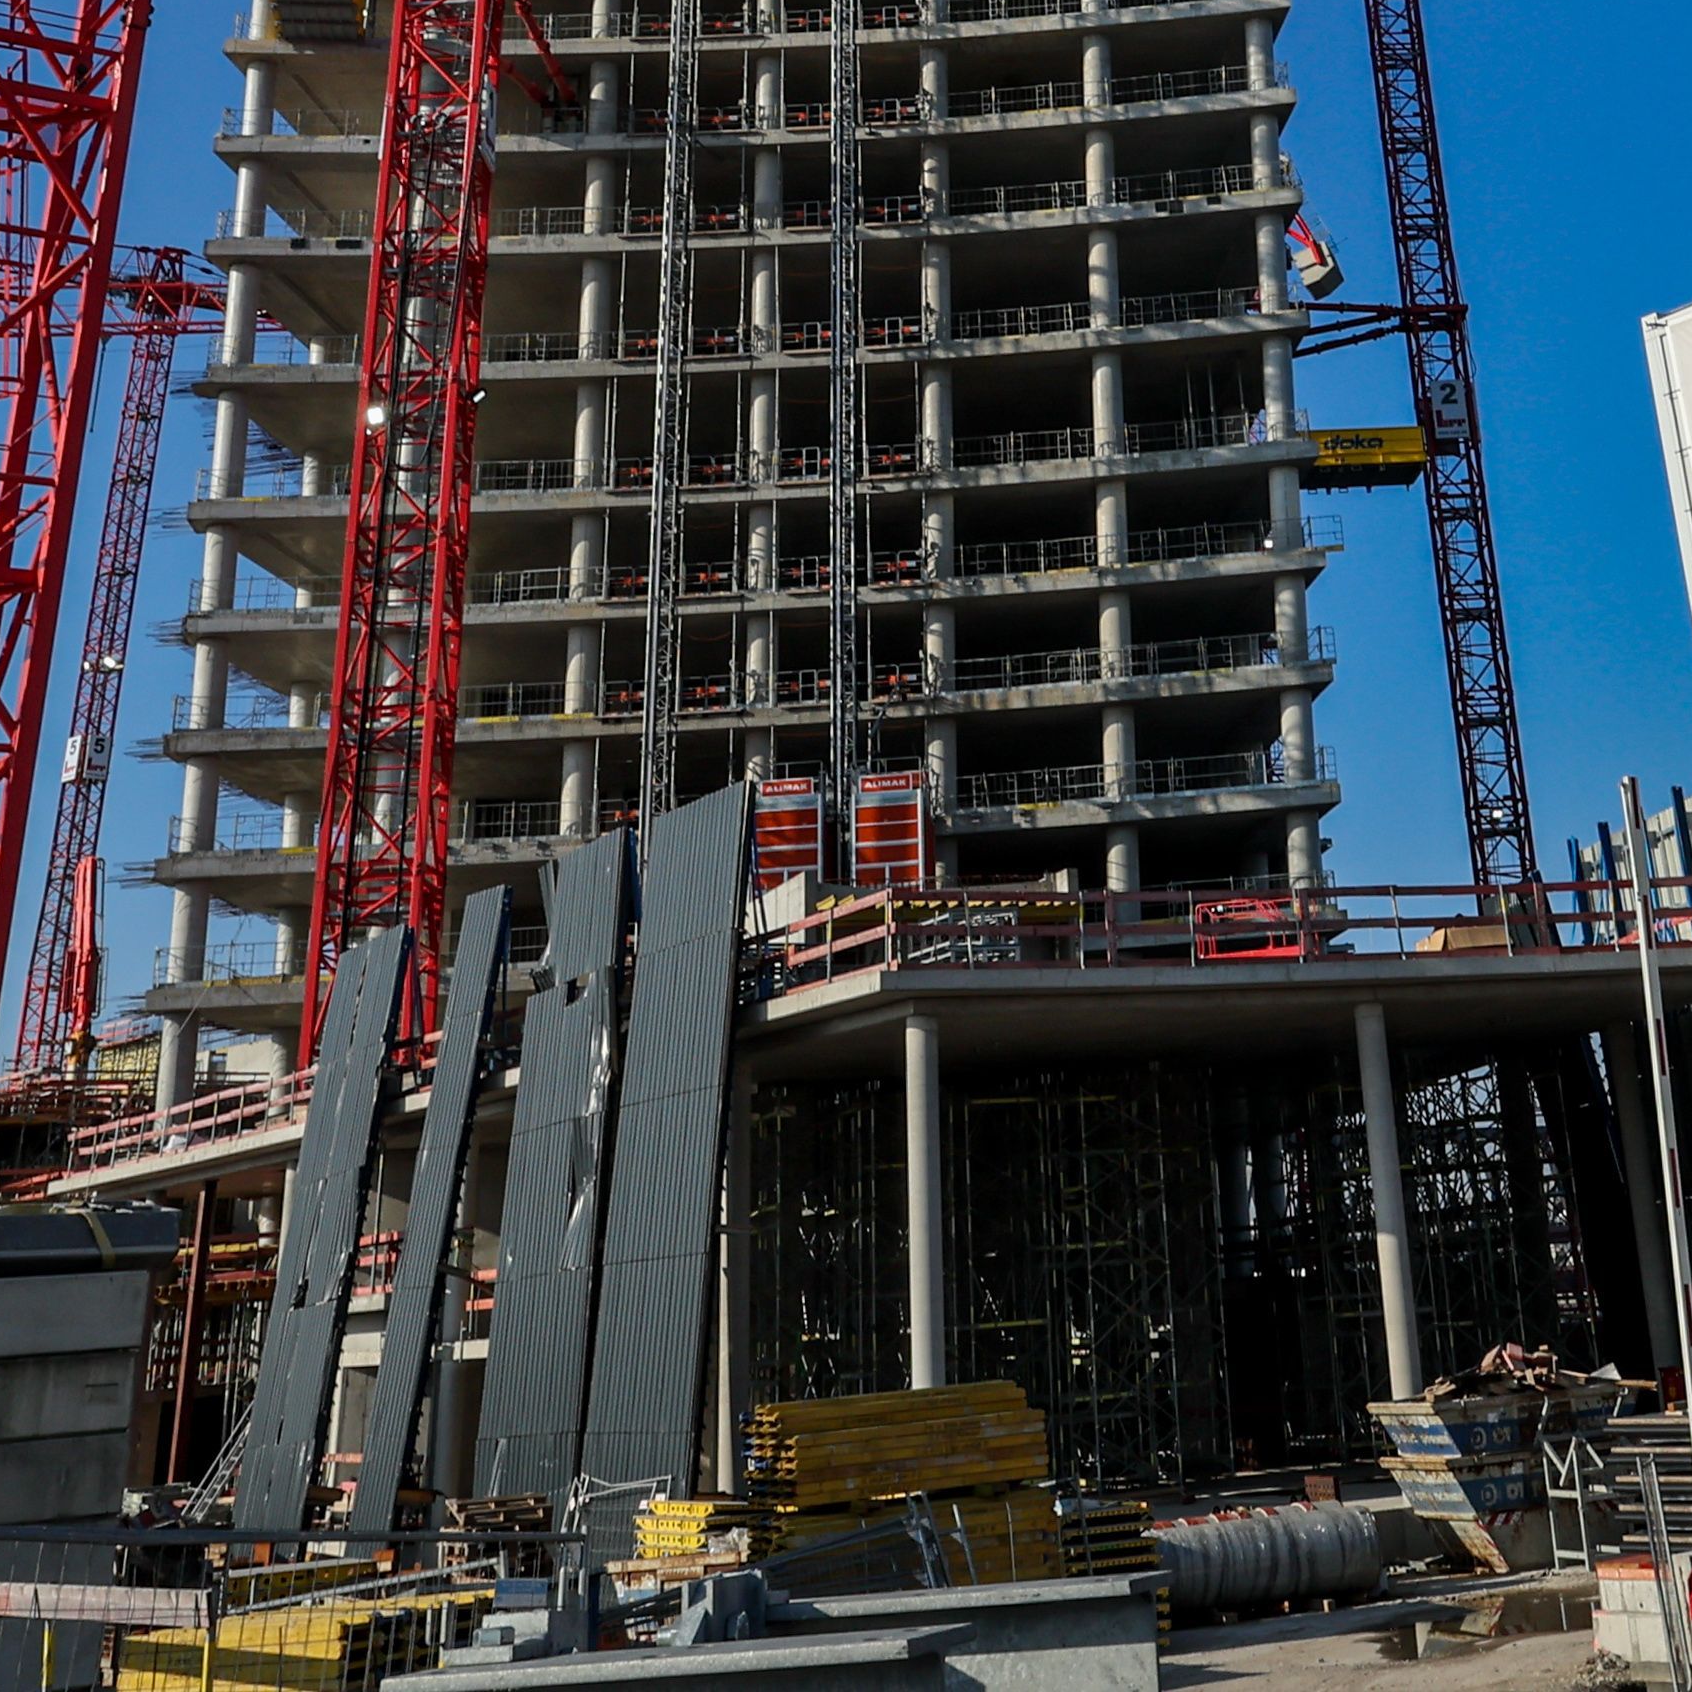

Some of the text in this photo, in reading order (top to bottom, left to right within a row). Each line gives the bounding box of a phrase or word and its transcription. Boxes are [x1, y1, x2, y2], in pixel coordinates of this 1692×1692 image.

[1439, 383, 1458, 404] 2
[1324, 434, 1384, 451] doka
[69, 739, 78, 755] 5
[93, 738, 105, 754] 5
[765, 783, 808, 793] ALIMAK
[863, 779, 907, 789] ALIMAK
